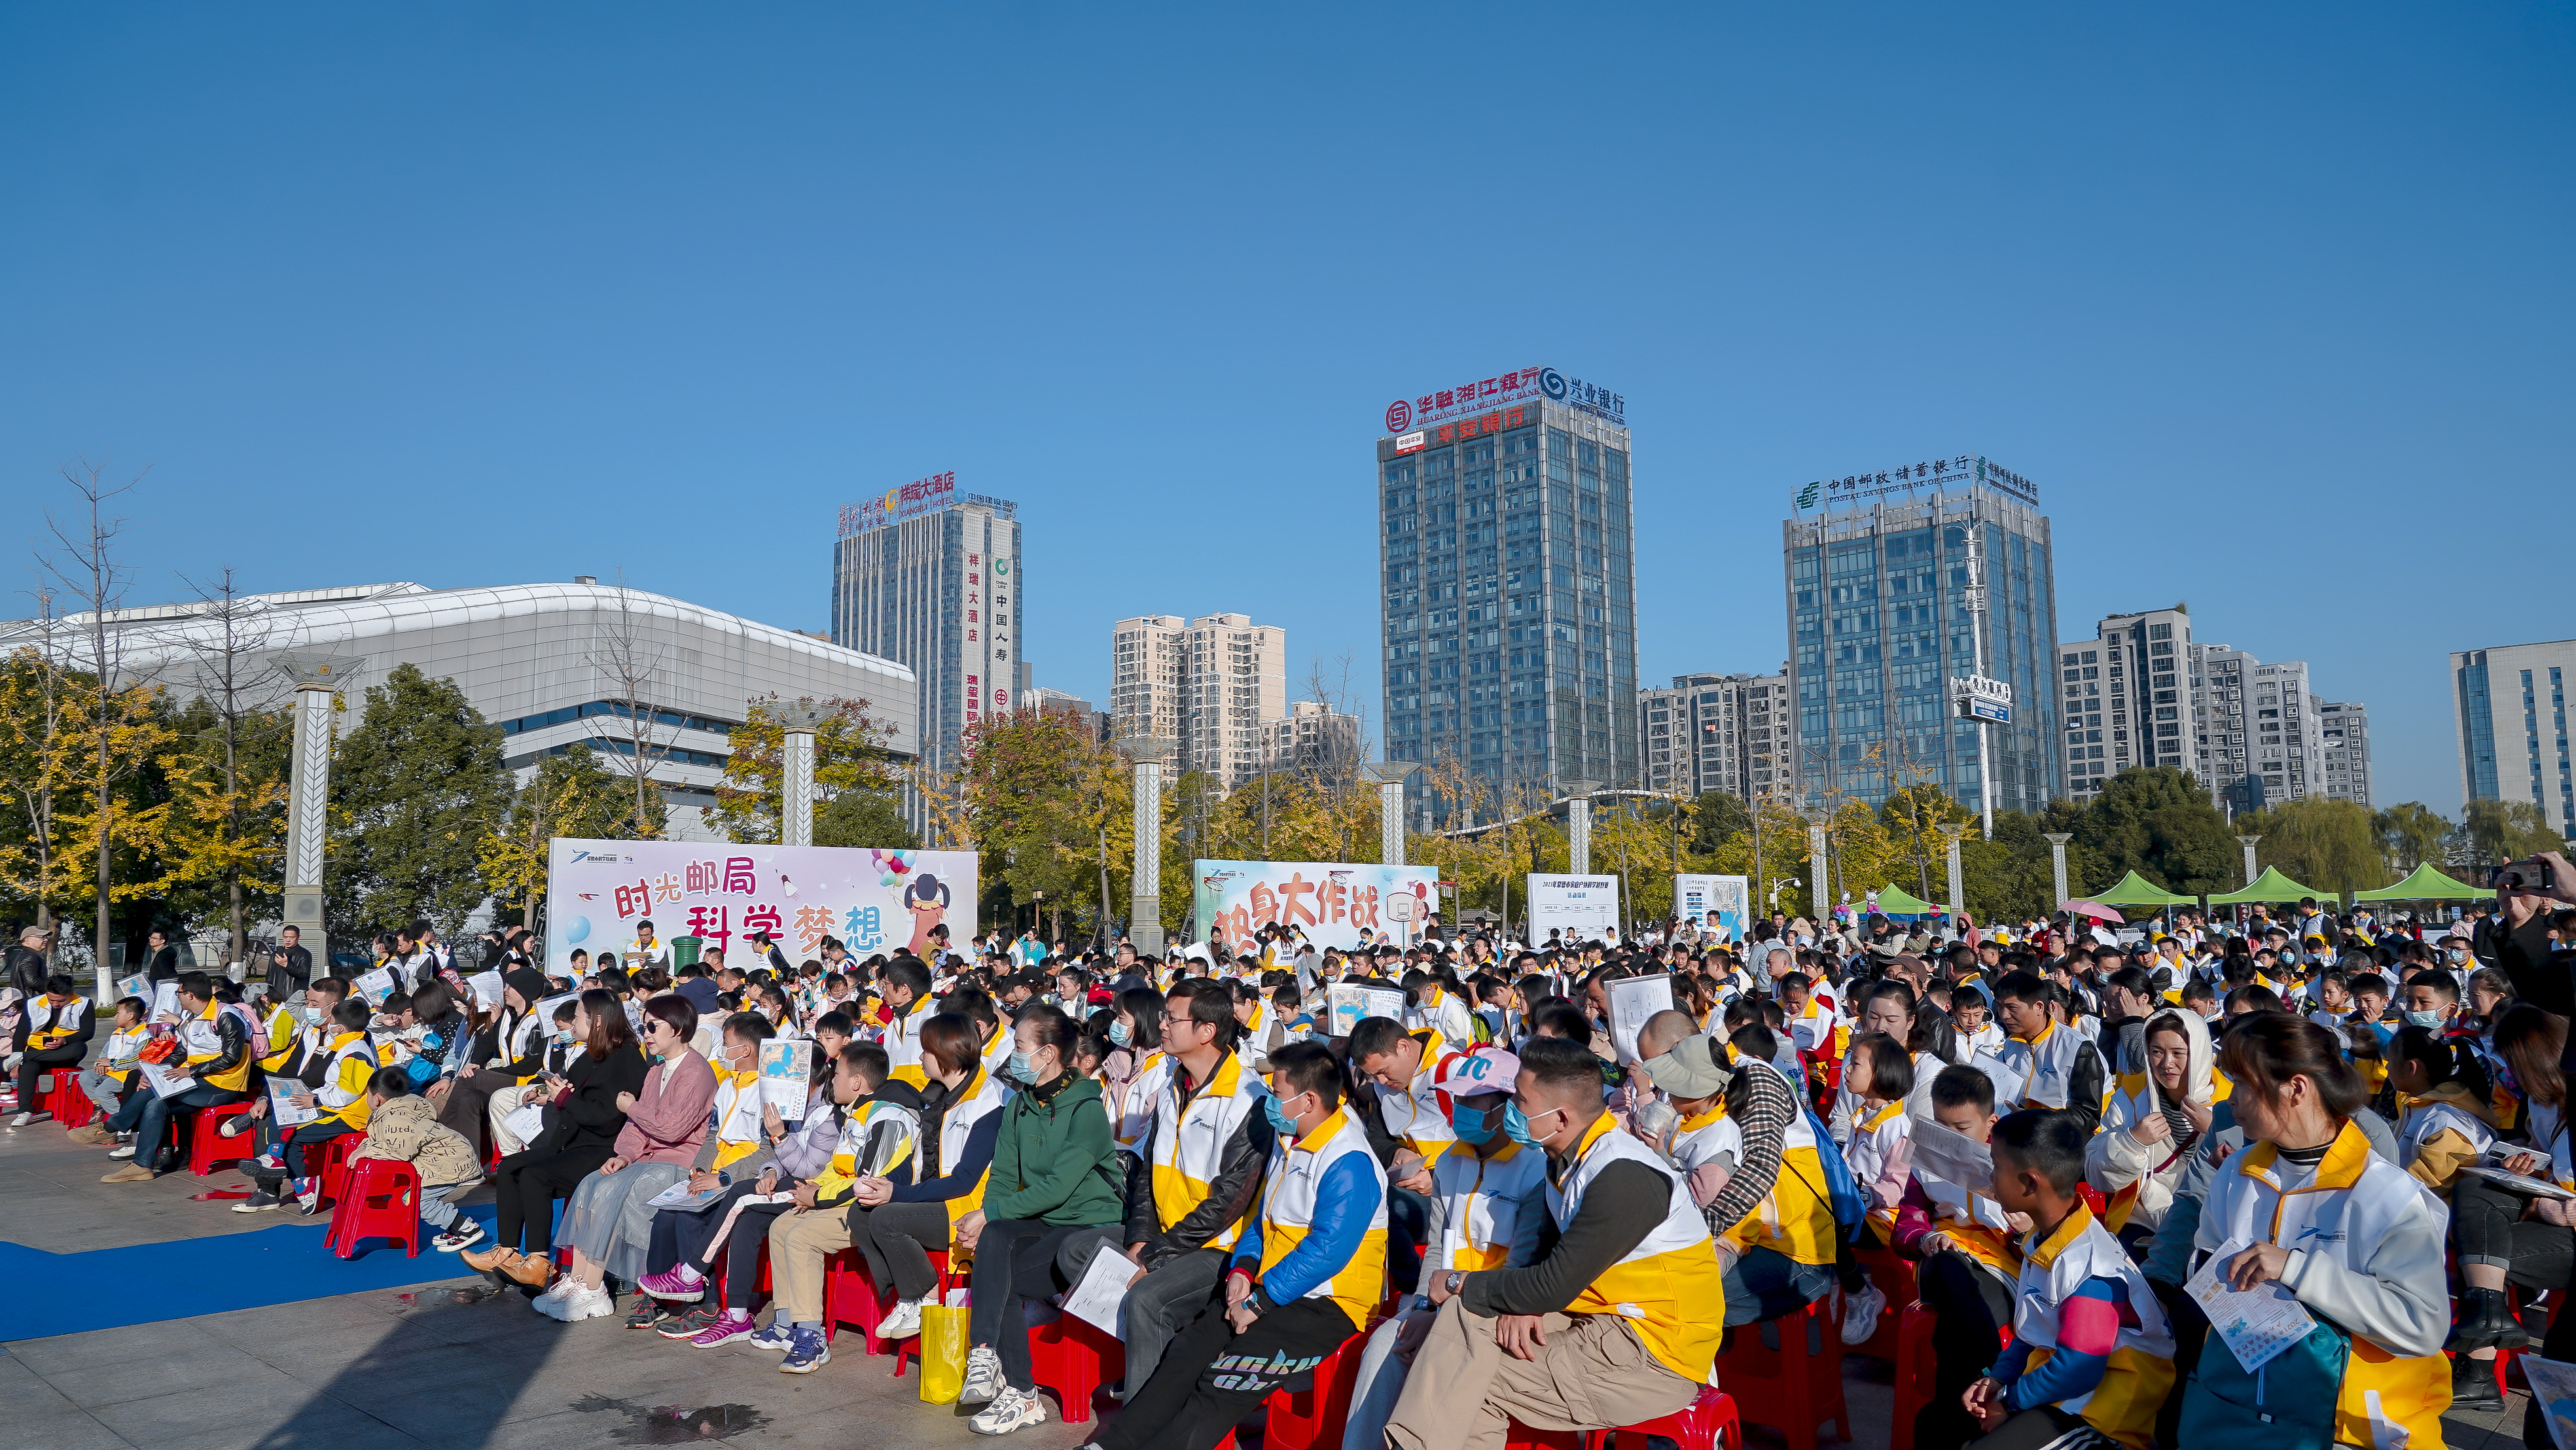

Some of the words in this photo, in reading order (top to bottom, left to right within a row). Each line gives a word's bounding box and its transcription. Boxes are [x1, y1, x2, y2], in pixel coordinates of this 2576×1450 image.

[1416, 366, 1541, 414] 华融湘江银行
[1417, 410, 1458, 425] HUARONG
[1460, 395, 1515, 414] XIANGJIANG
[1516, 387, 1541, 400] BANK
[1570, 376, 1624, 414] 兴业银行
[1399, 436, 1421, 445] 中国平安
[1437, 406, 1524, 443] 平安银行
[900, 470, 955, 505] 祥瑞大酒店
[1828, 455, 1969, 495] 中国邮政储蓄银行
[1829, 493, 1861, 503] POSTAL
[1863, 486, 1899, 497] SAVINGS
[1902, 480, 1925, 490] BANK
[1941, 473, 1969, 483] CHINA
[900, 504, 928, 518] XIANGRUI
[933, 497, 953, 508] HOTEL
[969, 493, 1018, 509] 中国建设银行
[968, 554, 979, 642] 祥瑞大酒店
[995, 594, 1008, 662] 中国人寿
[615, 857, 756, 919] 时光邮局
[687, 904, 883, 954] 科学梦想
